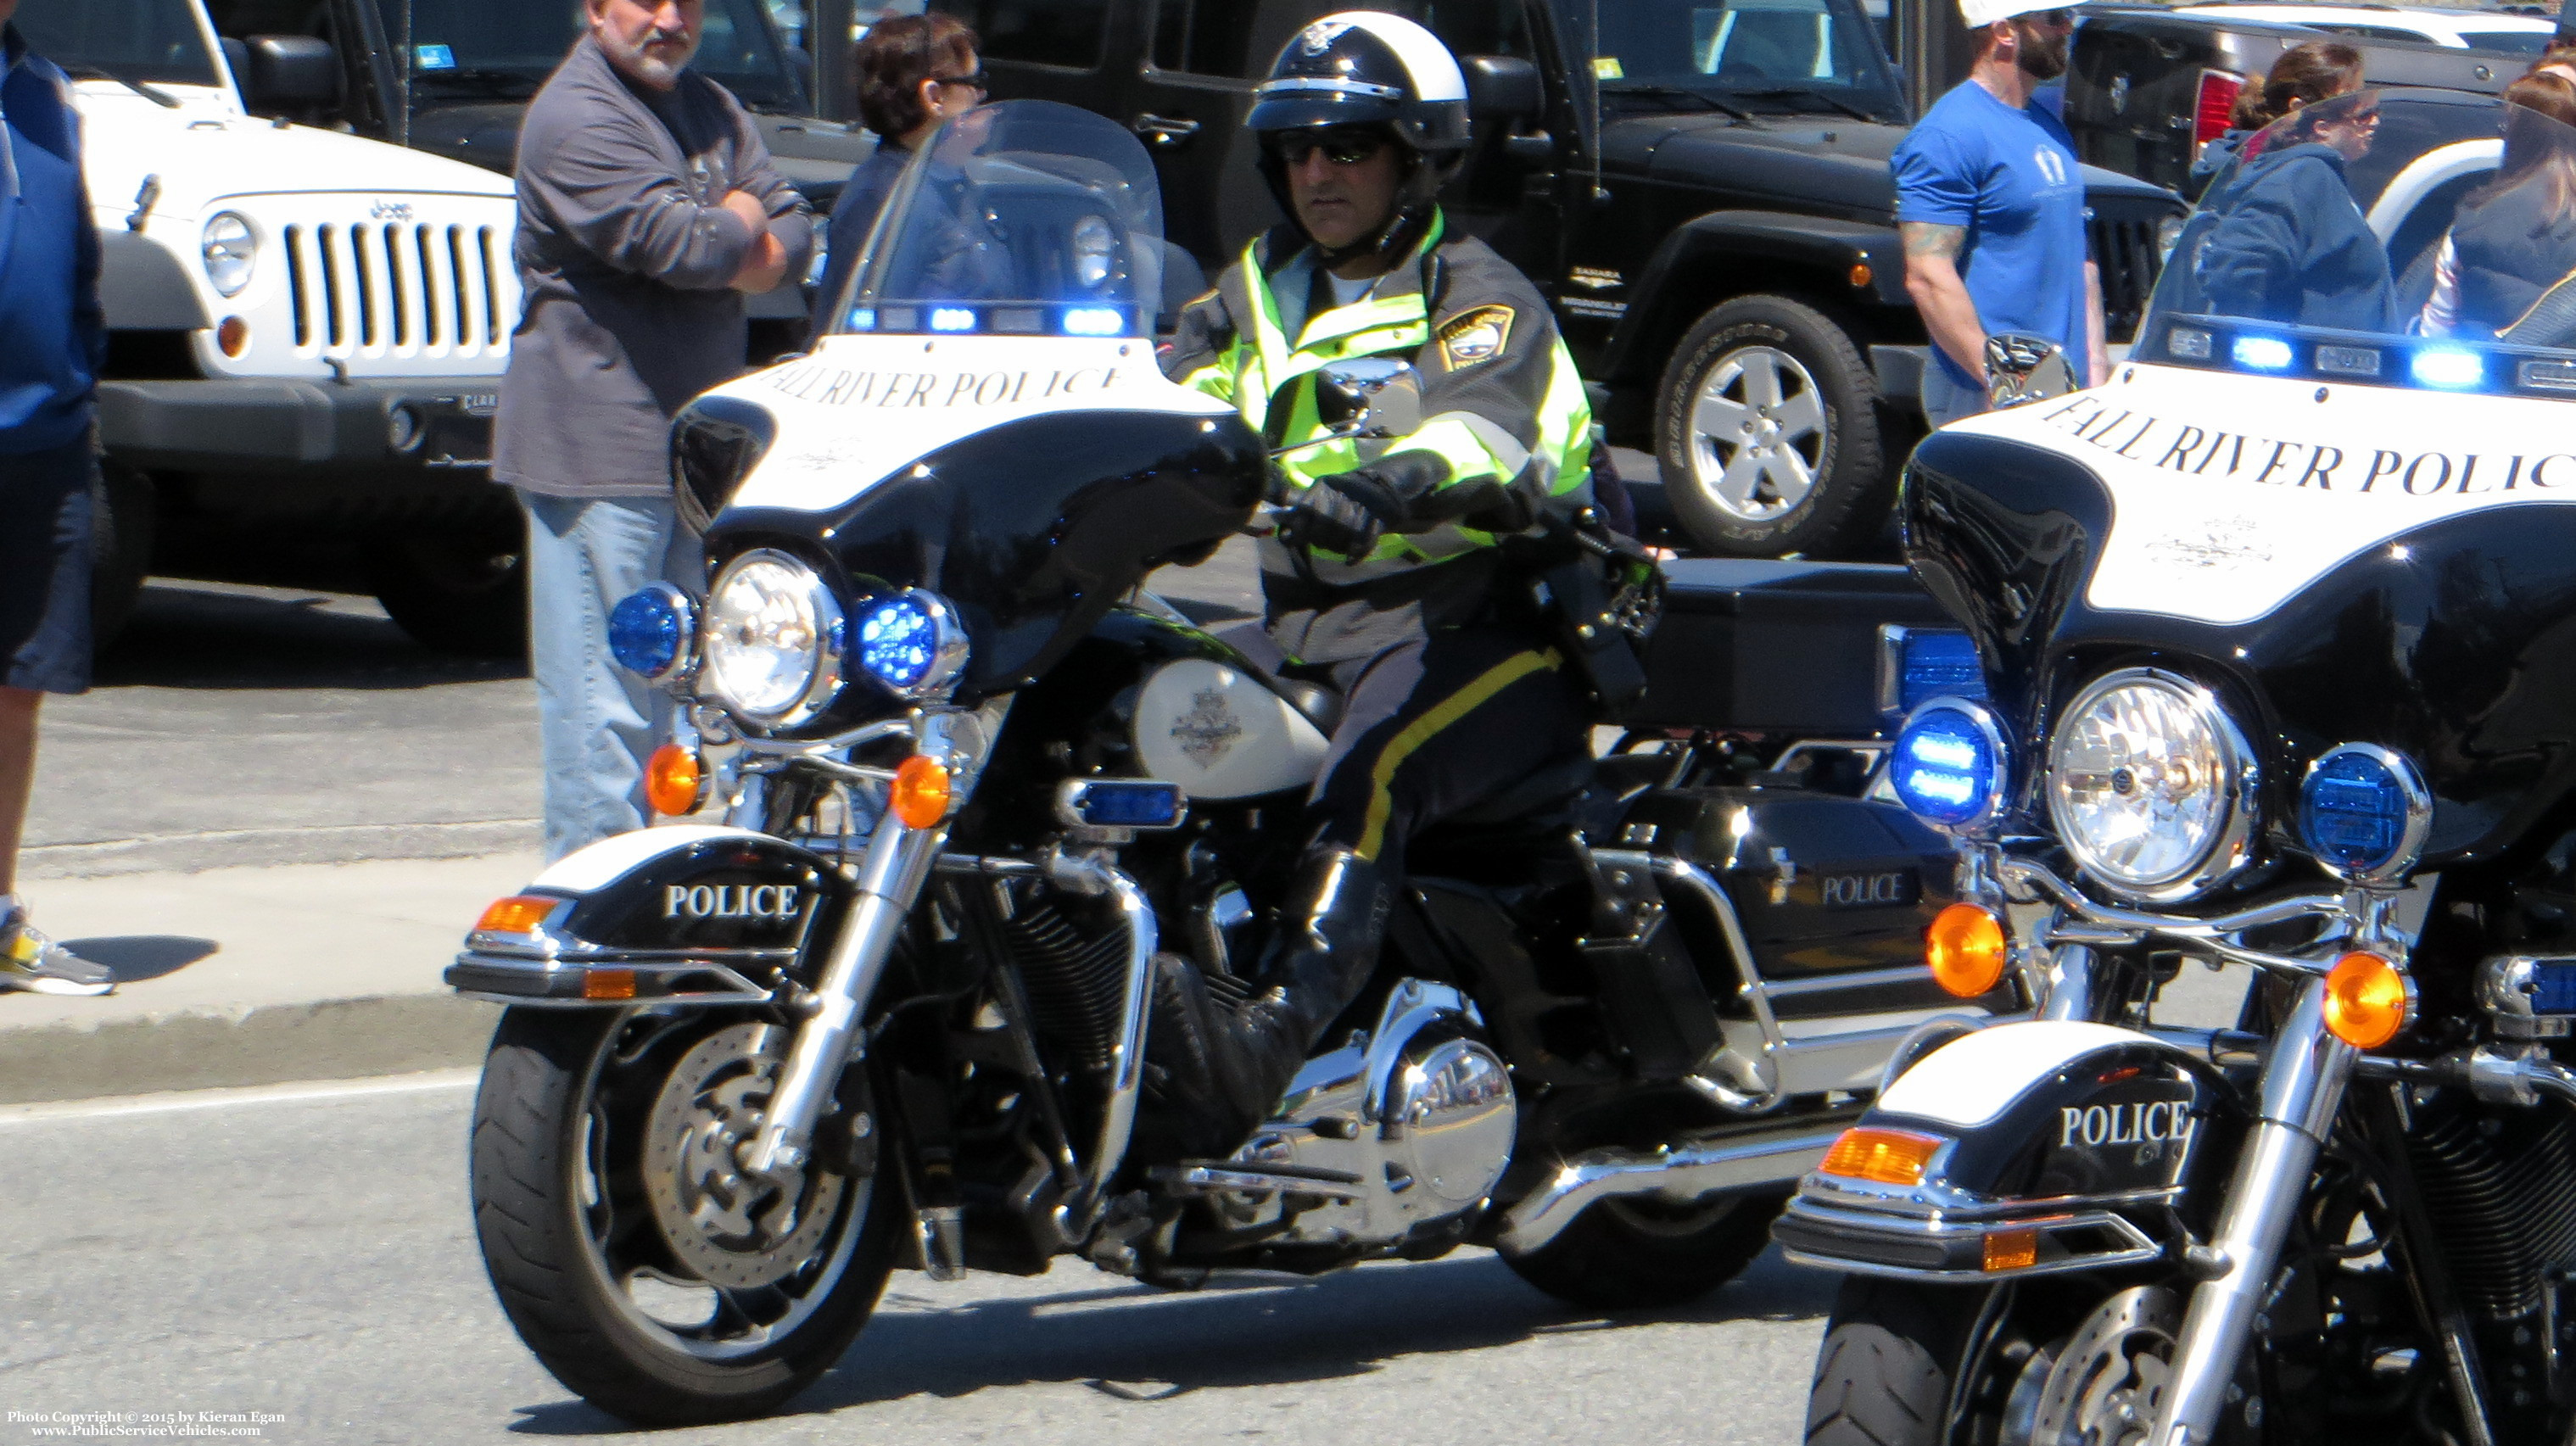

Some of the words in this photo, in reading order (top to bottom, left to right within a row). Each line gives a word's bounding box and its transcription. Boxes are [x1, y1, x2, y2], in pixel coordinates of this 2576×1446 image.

[370, 198, 413, 221] Jeep
[818, 369, 937, 407] RIVER
[2042, 395, 2159, 460] FALL
[2155, 425, 2344, 490] RIVER
[664, 885, 799, 917] POLICE
[1822, 873, 1903, 904] POLICE
[2059, 1100, 2191, 1147] POLICE
